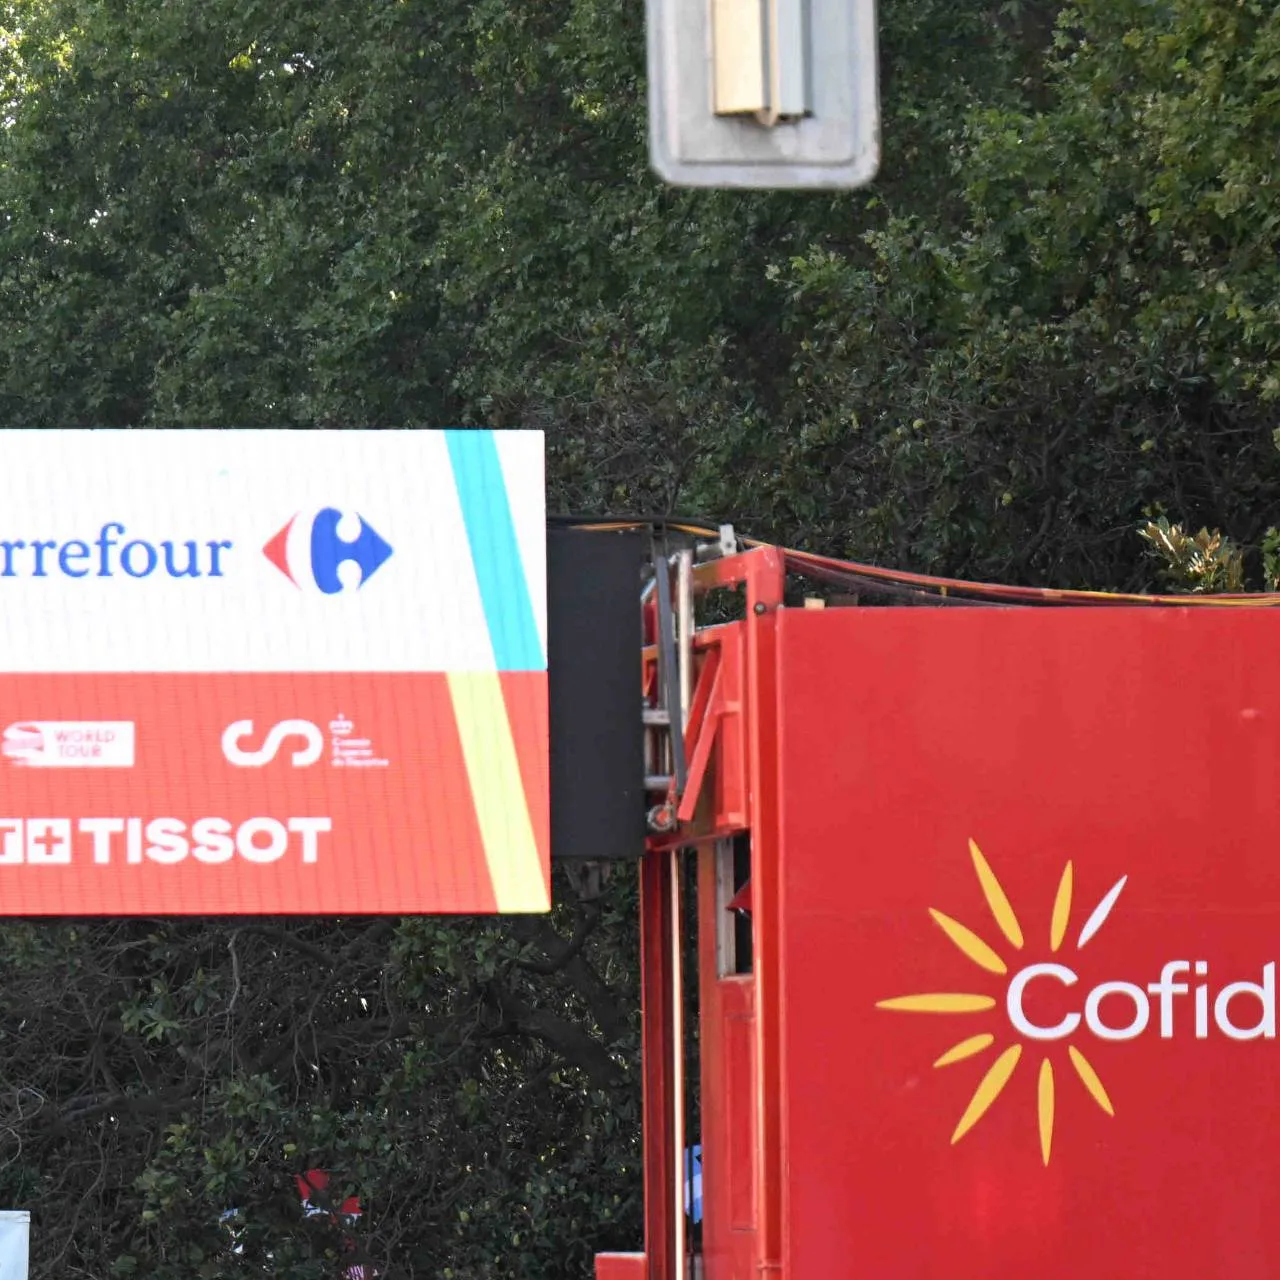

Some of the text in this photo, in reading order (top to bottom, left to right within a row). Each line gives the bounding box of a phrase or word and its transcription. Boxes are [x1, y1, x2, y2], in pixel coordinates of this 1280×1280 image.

[52, 728, 117, 744] WORLD
[57, 744, 103, 759] TOUR
[78, 816, 333, 866] TISSOT
